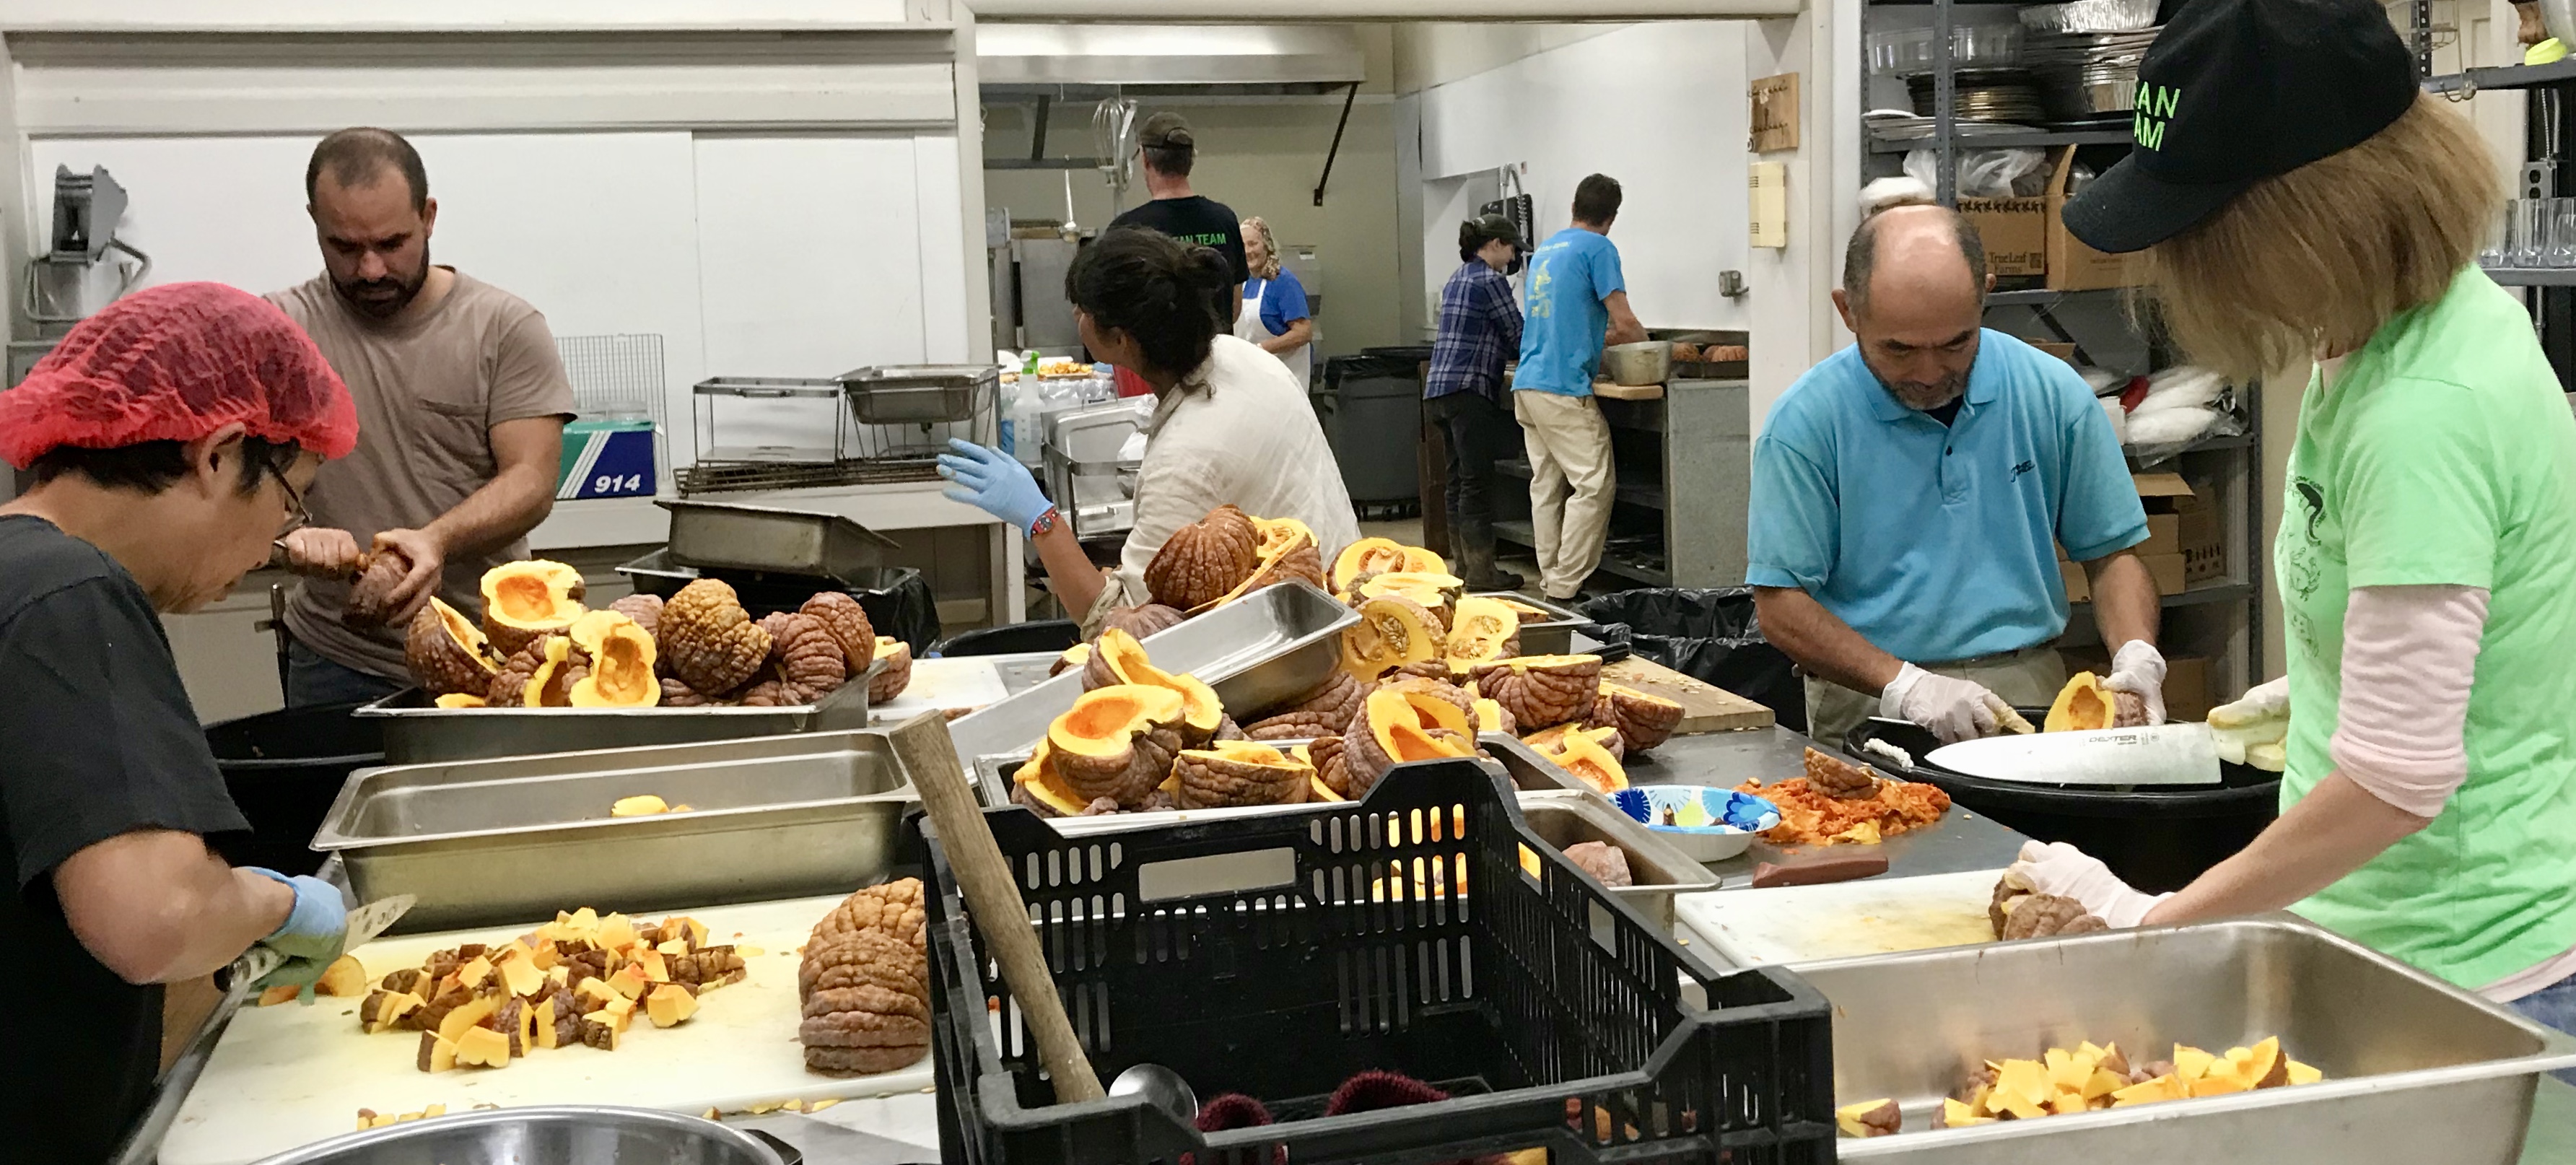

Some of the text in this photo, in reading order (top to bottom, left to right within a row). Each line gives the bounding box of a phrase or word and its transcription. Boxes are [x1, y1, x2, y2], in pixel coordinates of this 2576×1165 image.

[2136, 79, 2180, 119] AN
[1195, 233, 1226, 245] TEAM
[594, 474, 641, 493] 914
